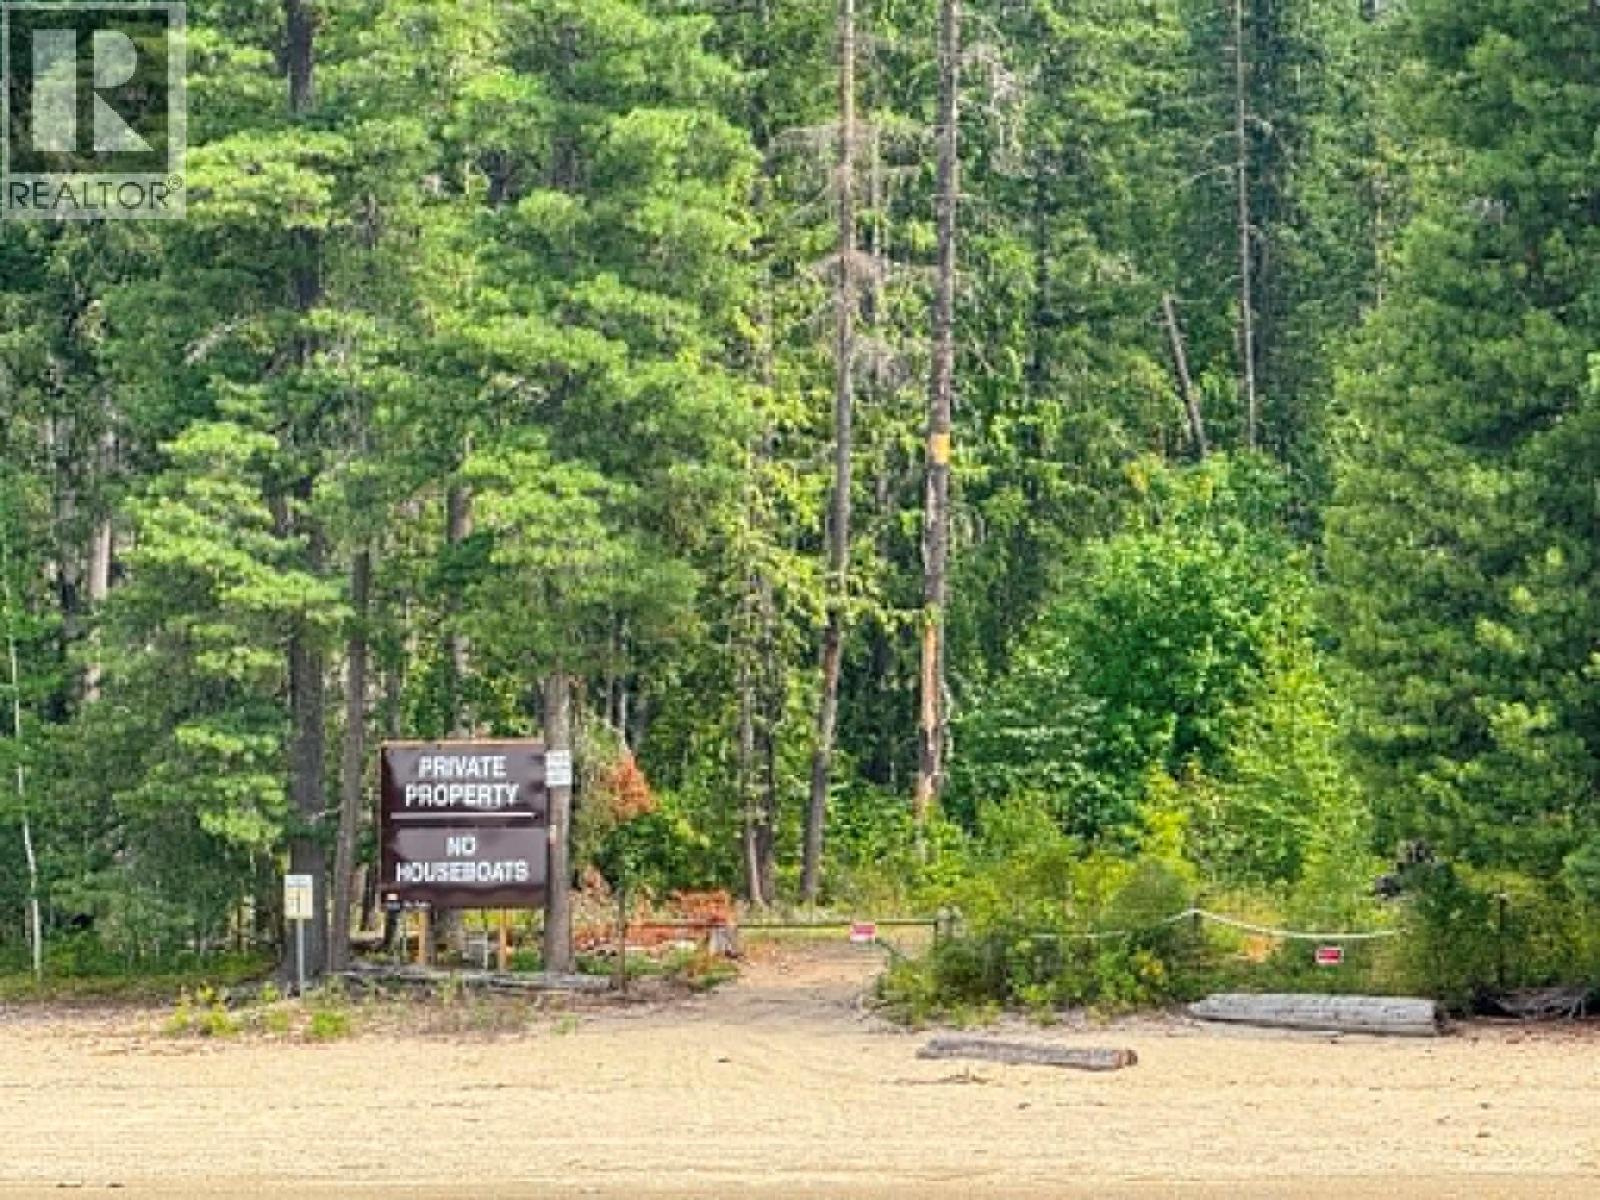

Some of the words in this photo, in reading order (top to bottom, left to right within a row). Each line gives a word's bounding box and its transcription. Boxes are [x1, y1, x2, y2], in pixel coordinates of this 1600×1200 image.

[418, 755, 507, 778] PRIVATE
[404, 783, 520, 807] PROPERTY
[447, 835, 476, 856] NO
[395, 860, 530, 882] HOUSEBOATS
